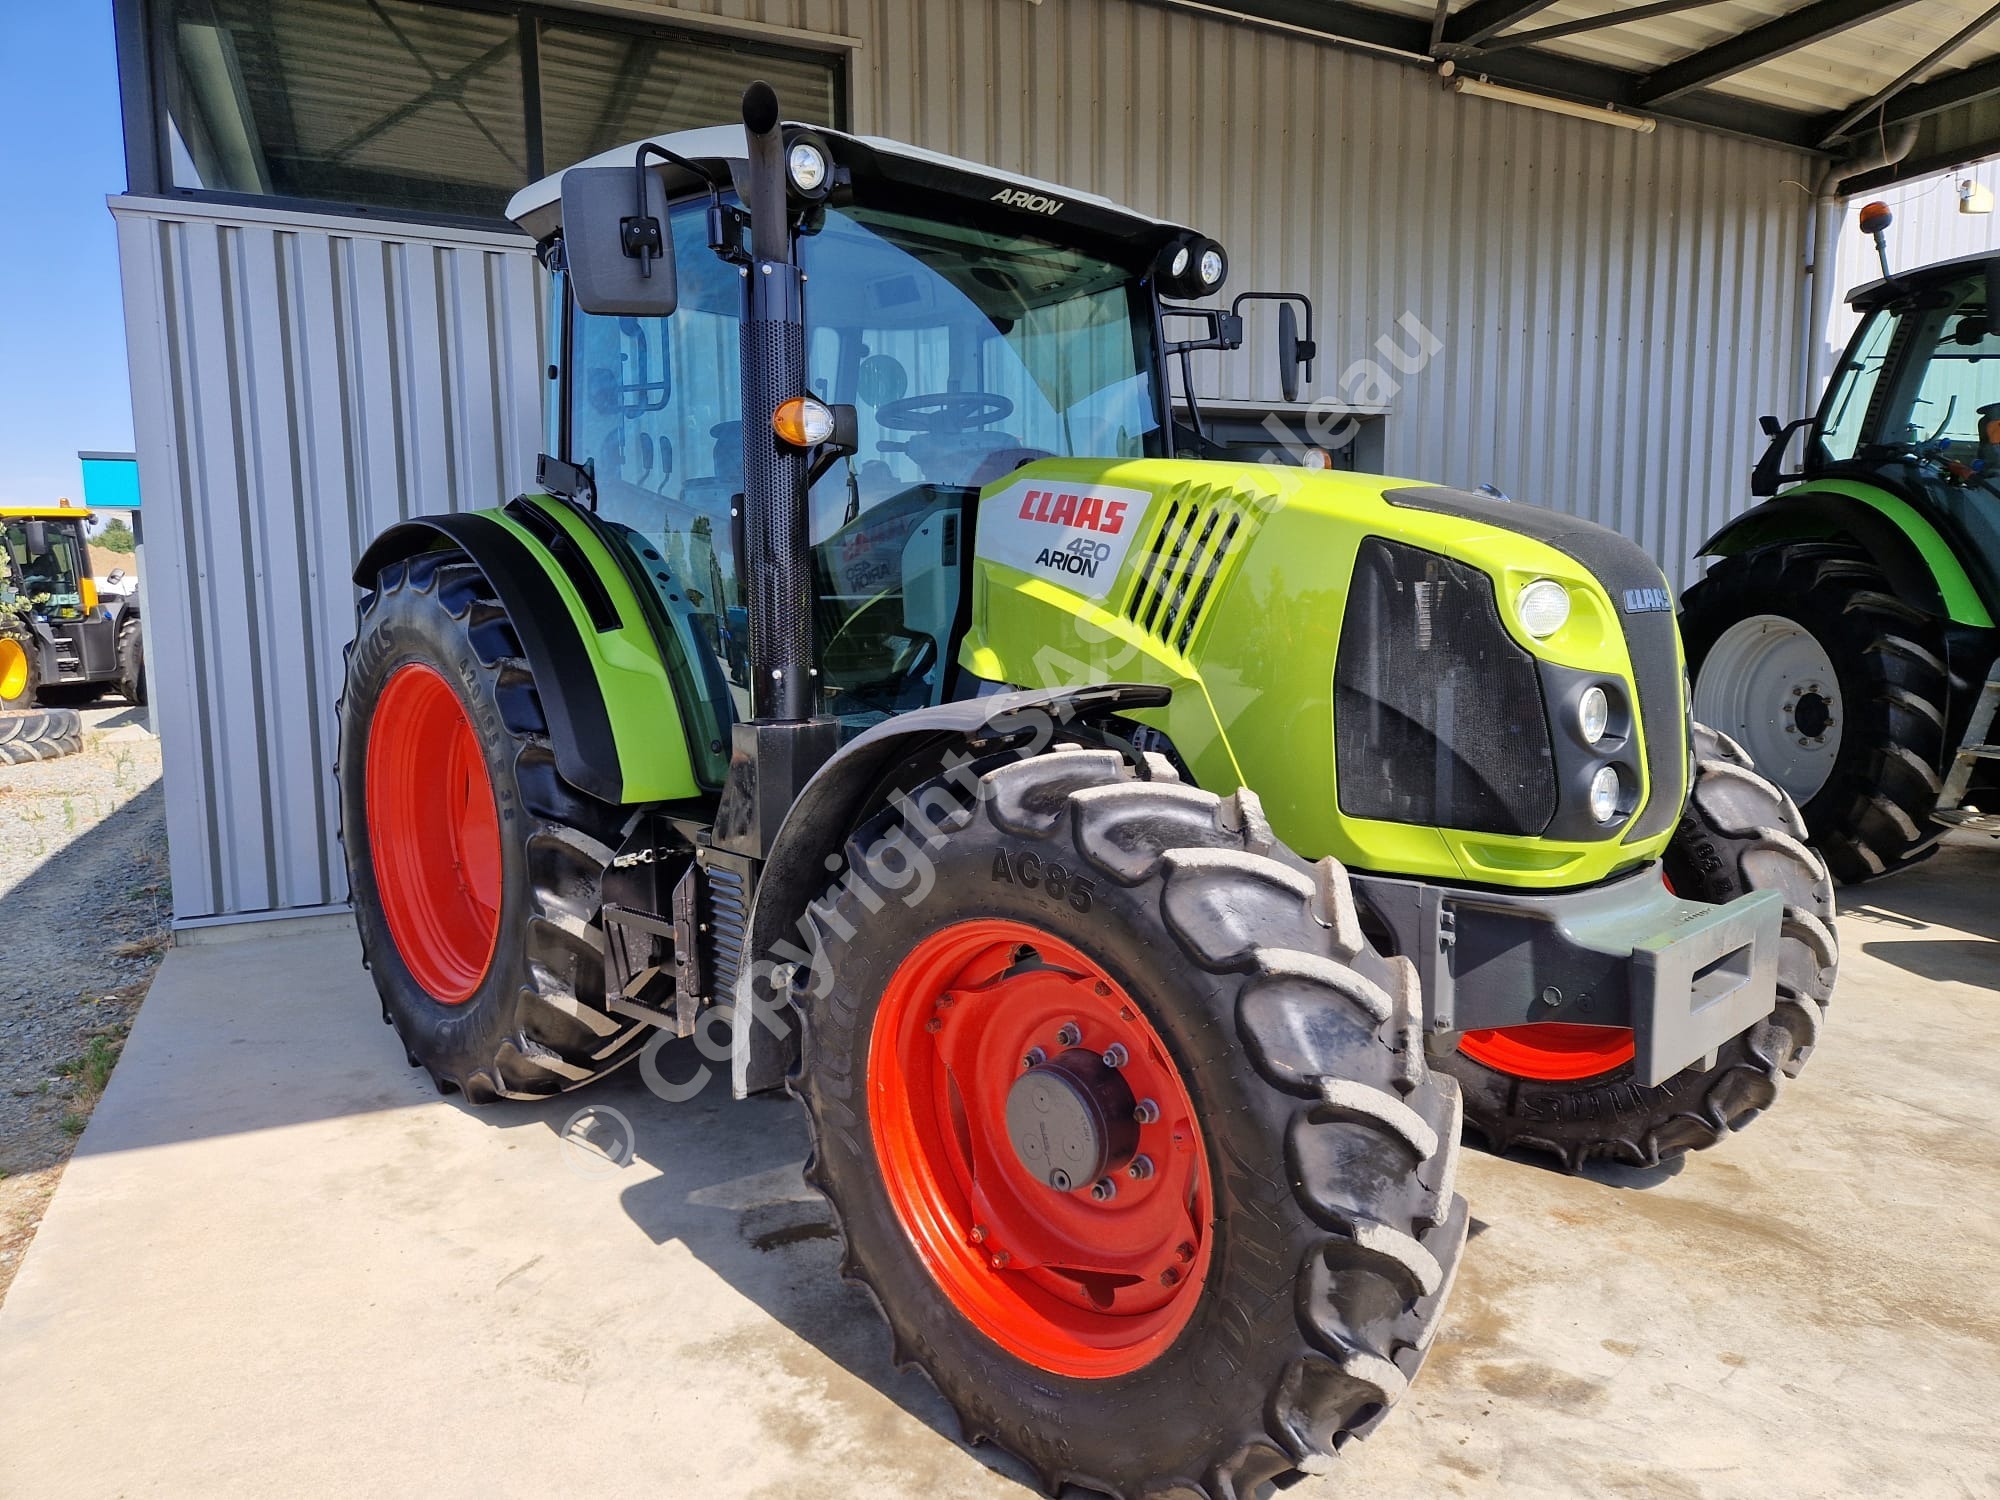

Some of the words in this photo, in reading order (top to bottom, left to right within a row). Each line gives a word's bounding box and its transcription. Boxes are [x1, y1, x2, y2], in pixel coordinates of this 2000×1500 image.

[990, 188, 1064, 216] ARION
[1018, 490, 1129, 535] CLAAS
[1034, 548, 1099, 579] ARION
[1065, 537, 1111, 562] 420
[46, 593, 81, 606] JCB
[990, 846, 1096, 914] AC85
